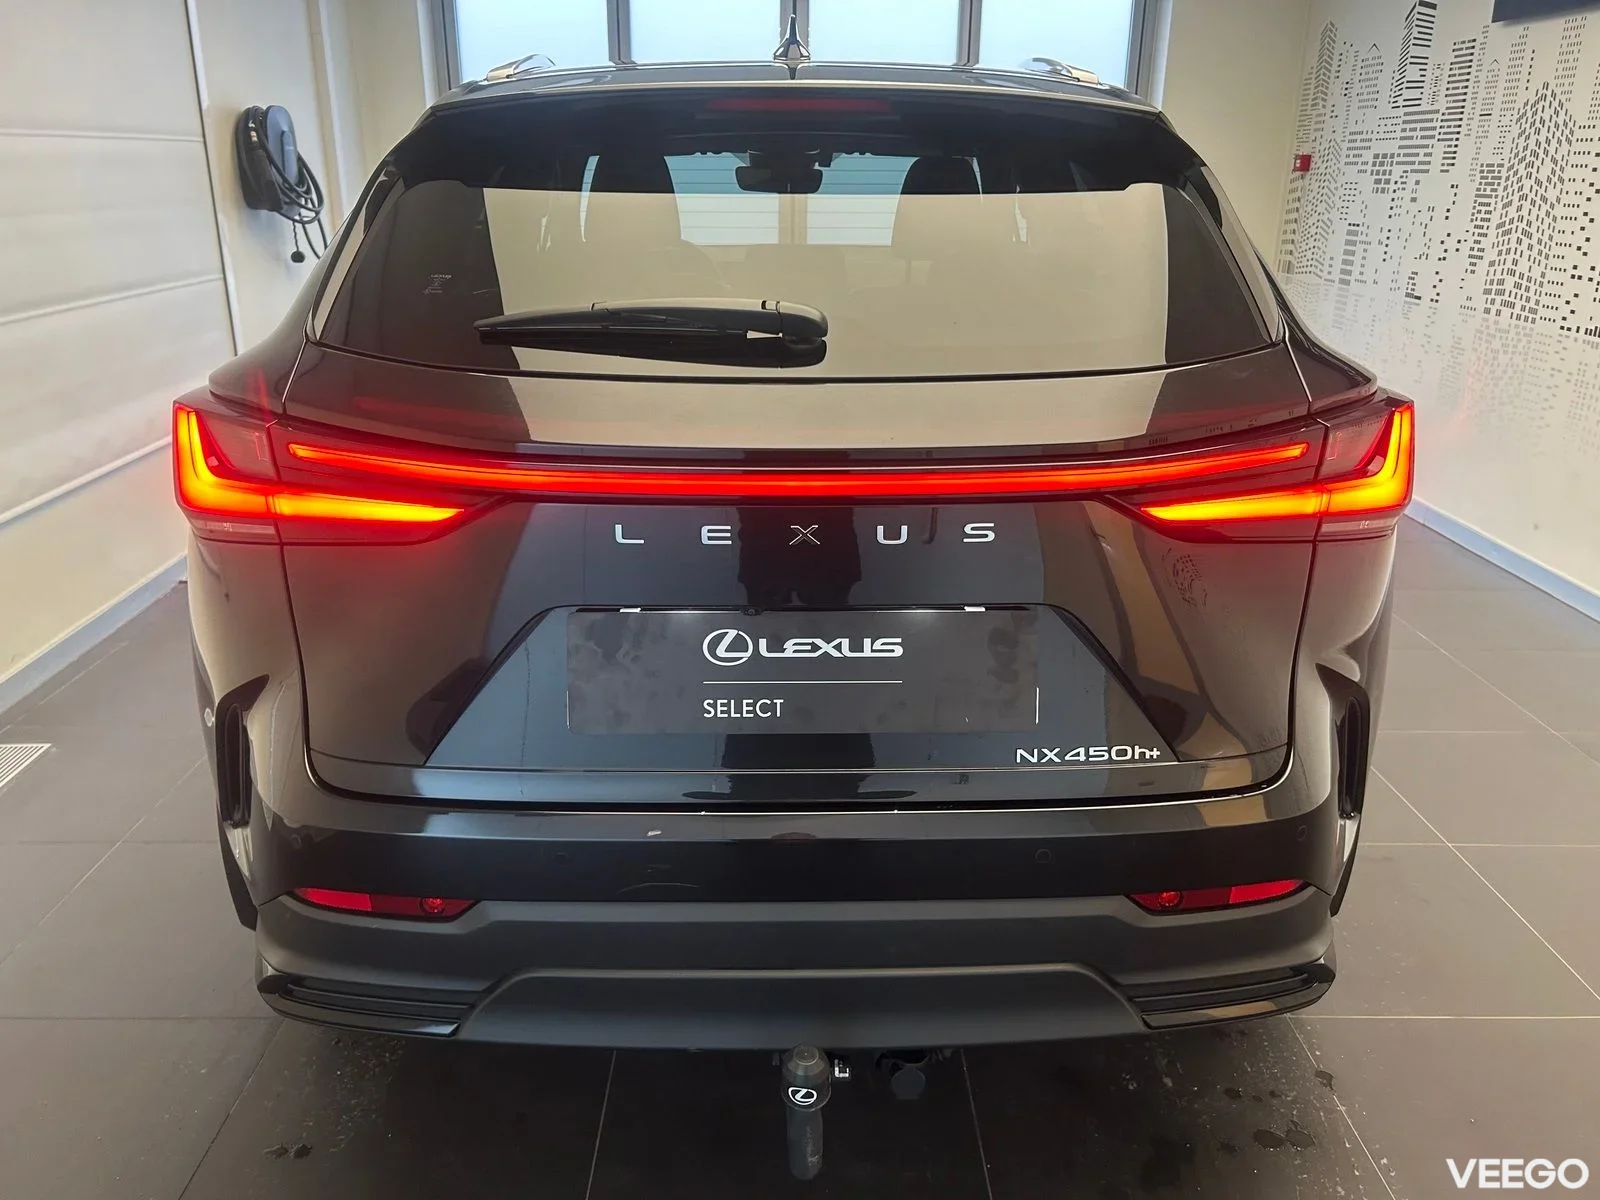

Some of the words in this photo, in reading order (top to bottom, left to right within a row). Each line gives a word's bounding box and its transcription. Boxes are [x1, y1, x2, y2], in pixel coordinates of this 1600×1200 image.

[614, 522, 996, 545] LEXUS
[758, 637, 904, 658] LEXUS
[703, 698, 784, 718] SELECT
[1016, 745, 1161, 763] NX450h+
